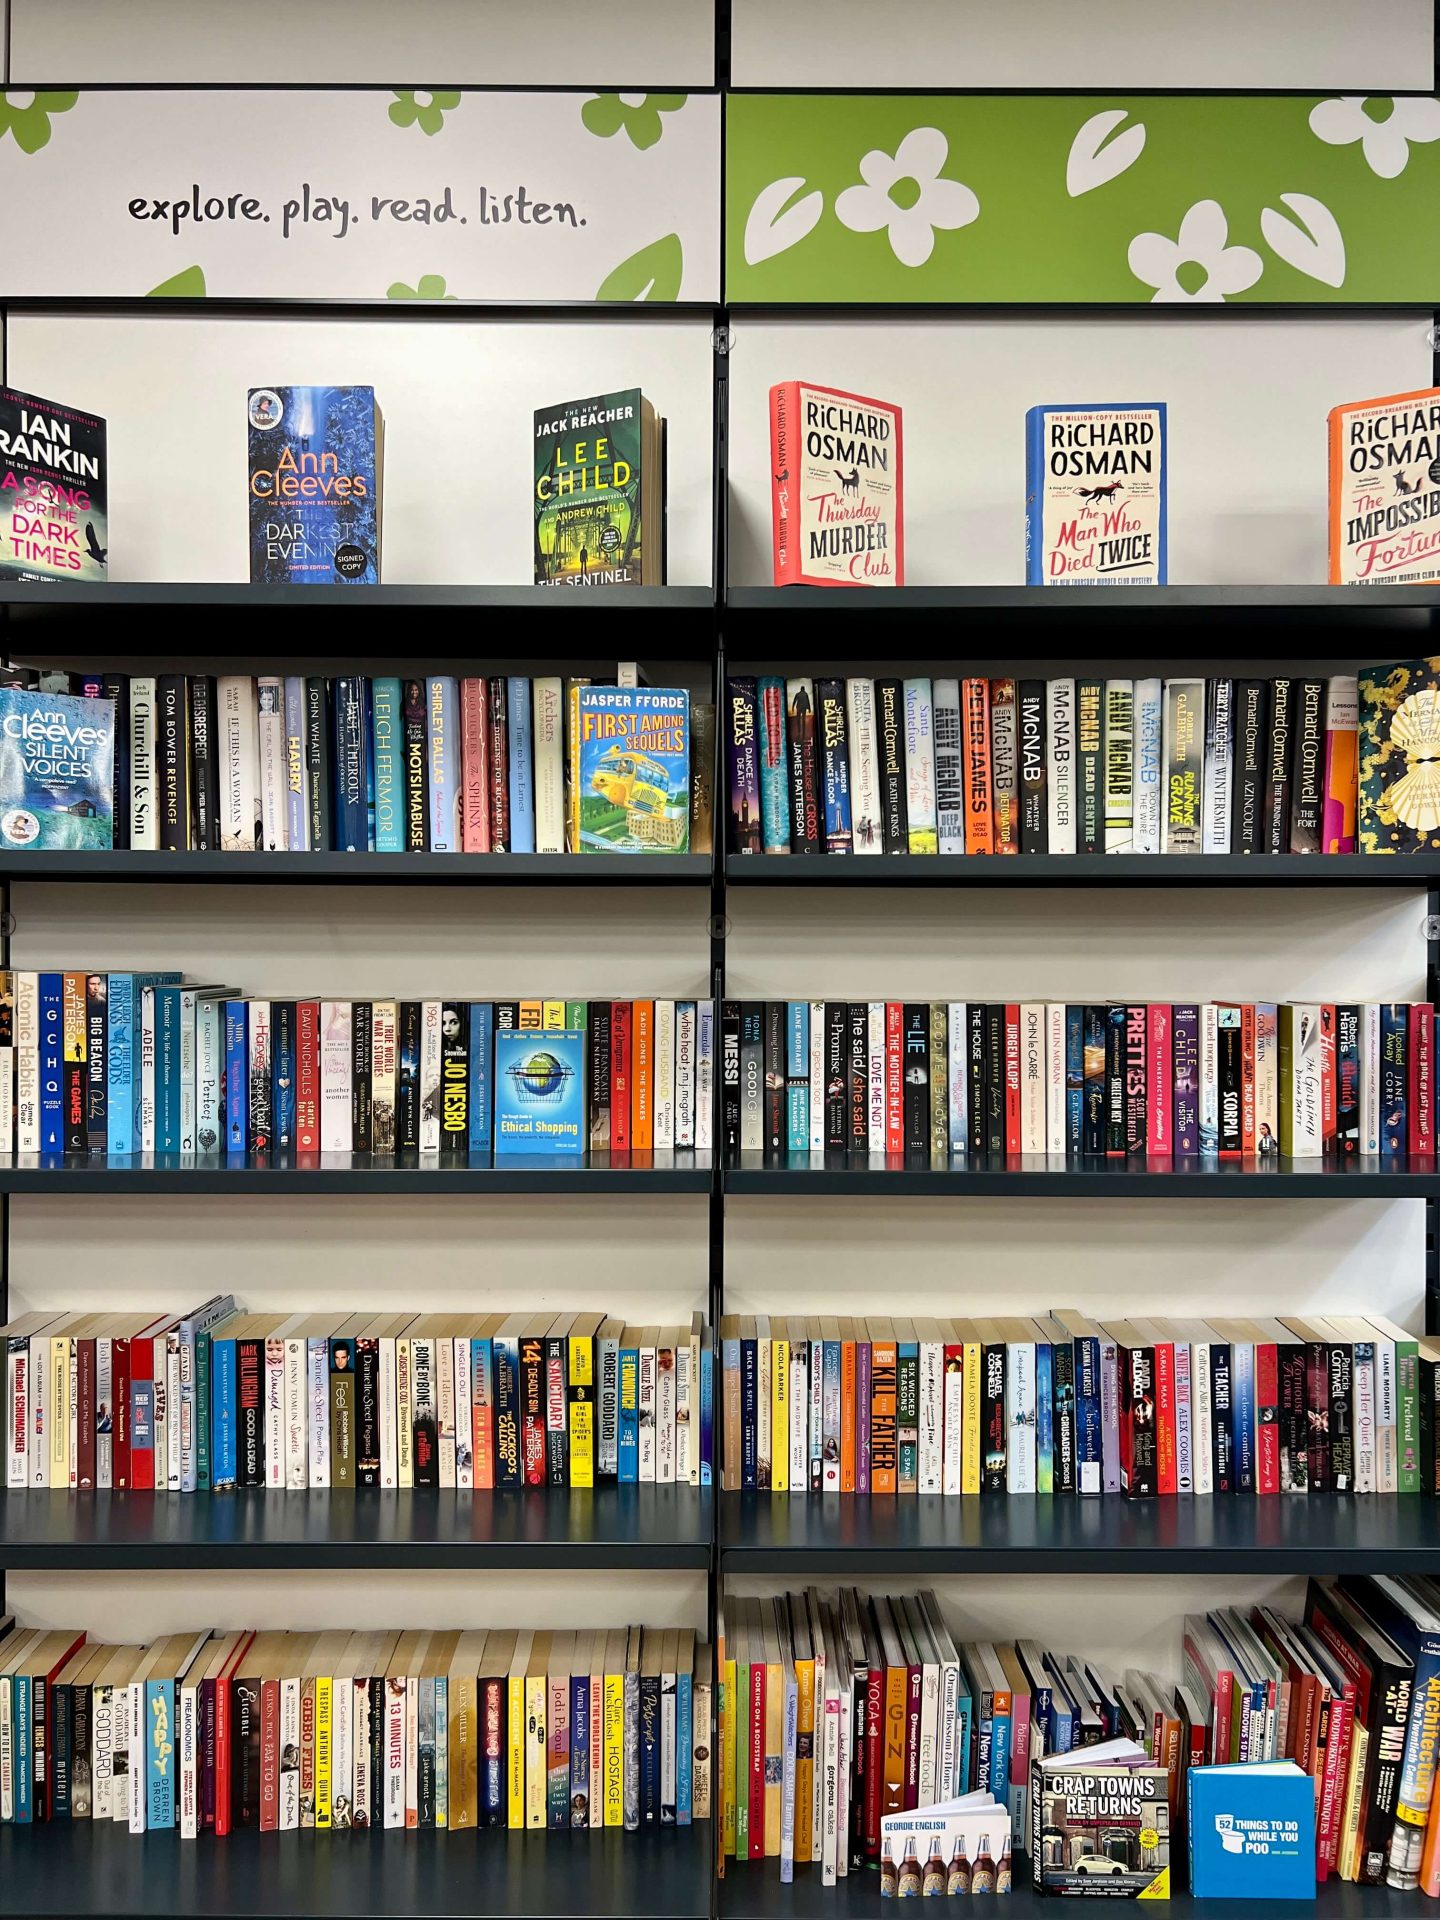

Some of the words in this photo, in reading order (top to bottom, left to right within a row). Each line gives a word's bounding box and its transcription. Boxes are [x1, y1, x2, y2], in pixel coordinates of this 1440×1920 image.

[128, 184, 271, 235] explore.
[283, 183, 359, 239] play.
[371, 186, 467, 225] read.
[479, 186, 587, 228] listen.
[21, 409, 71, 446] IAN
[536, 418, 567, 438] JACK
[571, 405, 634, 429] REACHER
[565, 408, 579, 417] THE
[582, 405, 599, 414] NEW
[277, 447, 338, 475] Ann
[556, 437, 608, 467] LEE
[807, 431, 888, 472] OSMAN
[1050, 449, 1152, 477] OSMAN
[1350, 434, 1440, 473] OSMA
[1, 471, 19, 490] A
[23, 476, 91, 511] SONG
[250, 467, 367, 498] Cleeves
[536, 461, 631, 501] CHILD
[15, 497, 47, 517] FOR
[50, 505, 77, 525] THE
[555, 506, 594, 522] ANDREW
[596, 502, 625, 515] CHILD
[812, 496, 881, 524] Thursday
[1078, 506, 1099, 520] The
[1101, 500, 1141, 537] Who
[1352, 494, 1383, 514] The
[13, 514, 80, 548] DARK
[810, 521, 888, 560] MURDER
[1055, 519, 1098, 551] Man
[9, 536, 82, 571] TIMES
[337, 554, 364, 564] SIGNED
[341, 562, 361, 571] COPY
[849, 551, 892, 580] Club
[1048, 544, 1095, 576] Died
[1098, 533, 1152, 567] TWICE
[566, 568, 632, 586] SENTINEL
[29, 708, 66, 725] Ann
[165, 688, 176, 716] TOM
[581, 694, 632, 708] JASPER
[635, 695, 685, 709] FFORDE
[969, 683, 985, 745] PETER
[1304, 683, 1321, 740] Bernard
[3, 714, 107, 747] Cleeves
[166, 720, 177, 765] BOWER
[582, 712, 639, 742] FIRST
[640, 714, 685, 732] AMONG
[626, 729, 685, 752] SEQUELS
[25, 741, 90, 761] SILENT
[409, 743, 423, 789] MOTSI
[793, 742, 803, 777] JAMES
[22, 759, 93, 778] VOICES
[970, 748, 987, 814] JAMES
[1301, 738, 1318, 805] Cornwell
[167, 767, 177, 826] REVENGE
[794, 778, 805, 837] PATTERSON
[1056, 765, 1069, 827] SILENCER
[1169, 774, 1184, 824] GRAVE
[1183, 771, 1195, 828] RUNNING
[1213, 766, 1226, 846] WINTERSMITH
[410, 789, 423, 847] MABUSE
[1297, 819, 1317, 829] FORT
[1300, 809, 1315, 818] THE
[90, 1017, 103, 1037] BIG
[301, 1008, 311, 1040] DAVID
[639, 1010, 647, 1033] SADIE
[794, 1006, 803, 1031] LIANE
[1339, 1011, 1350, 1053] Harris
[1347, 1016, 1358, 1048] Robert
[142, 1028, 153, 1068] ADELE
[639, 1038, 647, 1066] JONES
[724, 1033, 739, 1086] MESSI
[795, 1032, 803, 1074] MORIARTY
[889, 1033, 900, 1052] THE
[90, 1038, 103, 1083] BEACON
[301, 1042, 312, 1096] NICHOLLS
[444, 1058, 467, 1079] JO
[871, 1055, 882, 1085] LOVE
[1007, 1060, 1018, 1091] KLOPP
[639, 1069, 647, 1087] THE
[889, 1053, 900, 1131] MOTHER-IN-LAW
[639, 1089, 647, 1122] SNAKES
[872, 1087, 882, 1105] ME
[501, 1121, 533, 1133] Ethical
[535, 1121, 578, 1136] Shopping
[872, 1106, 882, 1130] NOT
[1223, 1091, 1239, 1138] SCORPIA
[549, 1341, 560, 1357] THE
[15, 1357, 26, 1393] Michael
[603, 1351, 616, 1392] ROBERT
[871, 1366, 896, 1399] KILL
[908, 1361, 916, 1376] SIX
[1331, 1349, 1345, 1399] Cornwell
[1342, 1357, 1352, 1391] Patricia
[548, 1358, 563, 1431] SANCTUARY
[900, 1367, 909, 1412] REASONS
[908, 1377, 916, 1418] WICKED
[15, 1393, 26, 1455] SCHUMACHER
[246, 1407, 257, 1436] GOOD
[603, 1392, 616, 1441] GODDARD
[1179, 1407, 1188, 1434] ALEX
[246, 1436, 257, 1449] AS
[497, 1414, 508, 1461] CALLING
[506, 1420, 518, 1475] CUCKOO'S
[871, 1414, 896, 1471] FATHER
[246, 1449, 257, 1475] DEAD
[1179, 1435, 1189, 1475] COOMBS
[390, 1700, 402, 1716] 13
[552, 1685, 566, 1713] Jodi
[867, 1680, 881, 1722] YOGA
[1394, 1679, 1413, 1725] WORLD
[151, 1695, 173, 1777] HAPPY
[184, 1697, 193, 1763] FREAKONOMICS
[389, 1718, 402, 1770] MINUTES
[554, 1715, 566, 1760] Picoult
[888, 1704, 905, 1760] GIN
[1016, 1723, 1028, 1756] Poland
[1377, 1725, 1405, 1764] WAR
[608, 1746, 620, 1806] HOSTAGE
[1052, 1776, 1095, 1796] CRAP
[1098, 1776, 1156, 1797] TOWNS
[152, 1781, 162, 1822] BROWN
[160, 1778, 169, 1823] DERREN
[1065, 1796, 1143, 1816] RETURNS
[1319, 1778, 1335, 1836] TECHNIQUES
[884, 1821, 915, 1832] GEORDIE
[915, 1820, 946, 1831] ENGLISH
[1219, 1819, 1232, 1830] 52
[1234, 1819, 1268, 1831] THINGS
[1270, 1820, 1283, 1831] TO
[1284, 1820, 1299, 1831] DO
[1247, 1832, 1278, 1843] WHILE
[1279, 1832, 1299, 1843] YOU
[1245, 1842, 1270, 1855] POO
